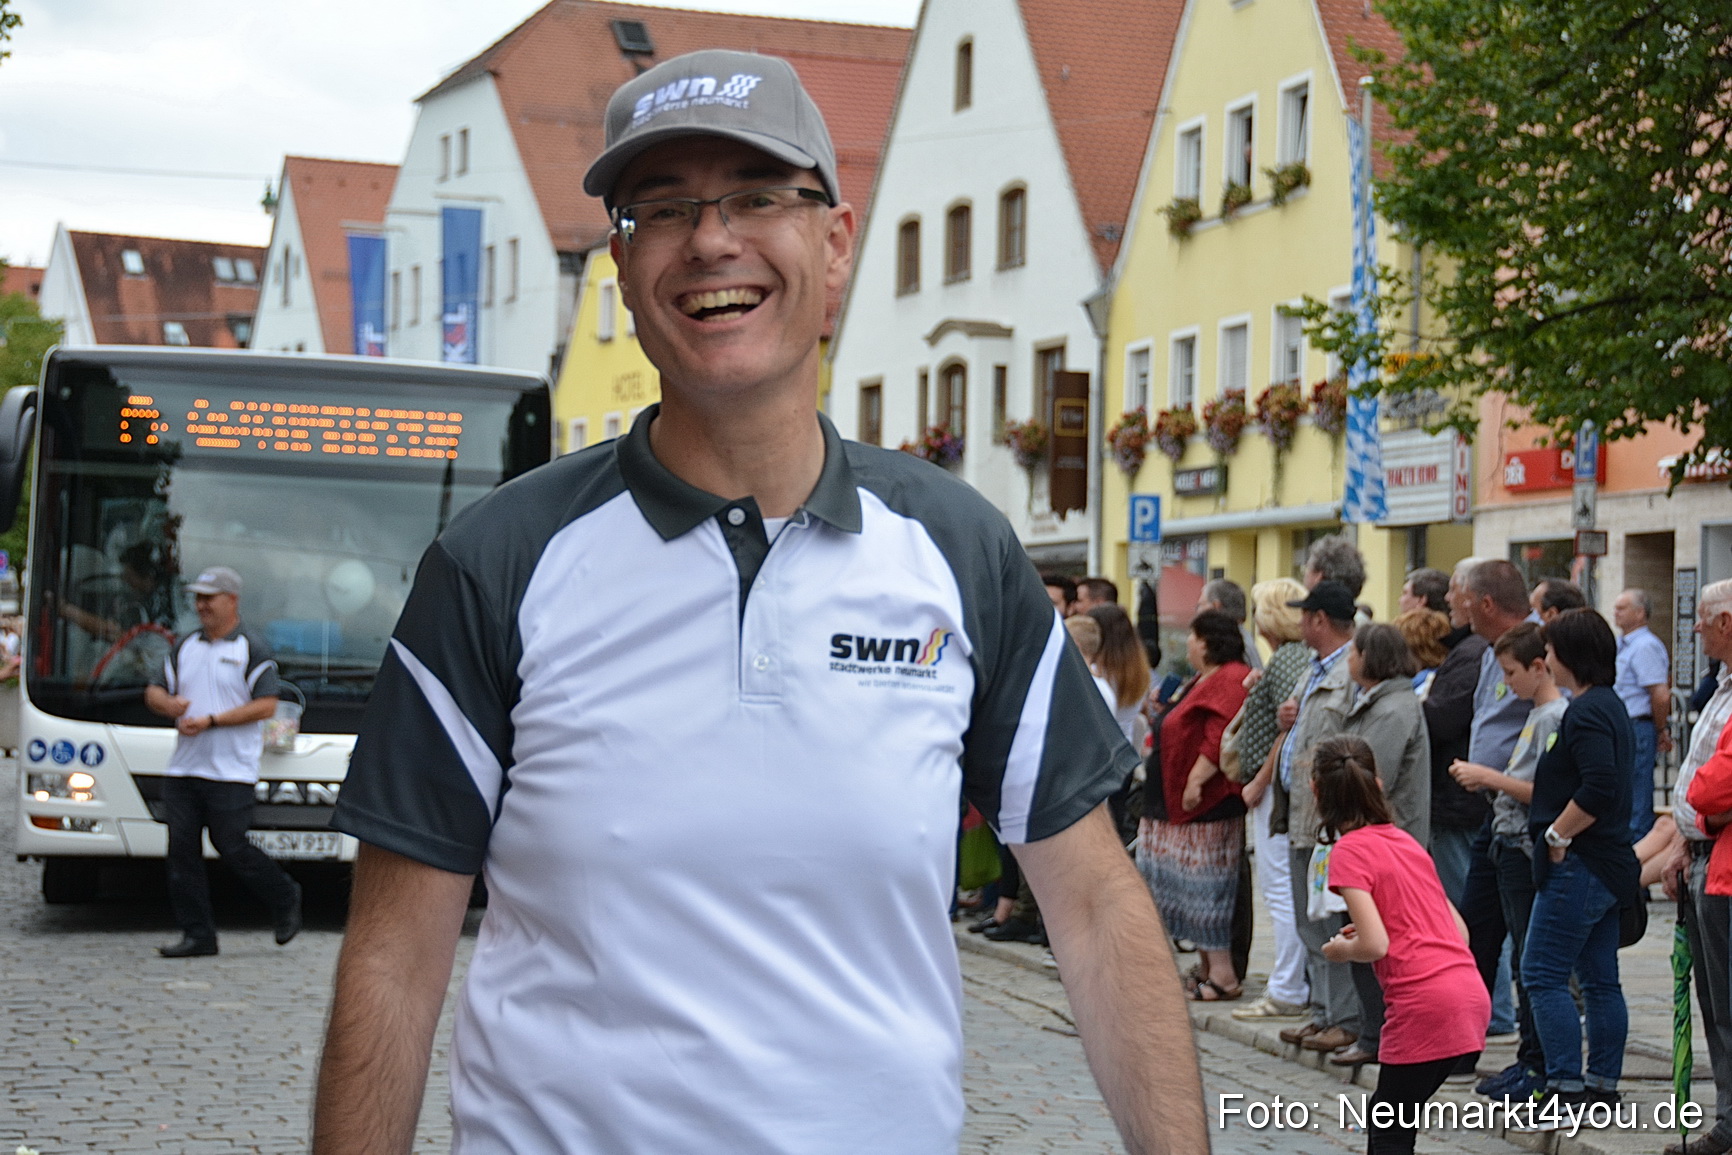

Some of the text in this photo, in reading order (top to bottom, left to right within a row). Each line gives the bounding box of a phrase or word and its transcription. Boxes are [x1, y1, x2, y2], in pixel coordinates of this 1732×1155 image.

[632, 76, 718, 119] swn
[1134, 499, 1156, 538] P
[829, 633, 921, 663] swn
[829, 662, 938, 679] stadtwerke neumarkt
